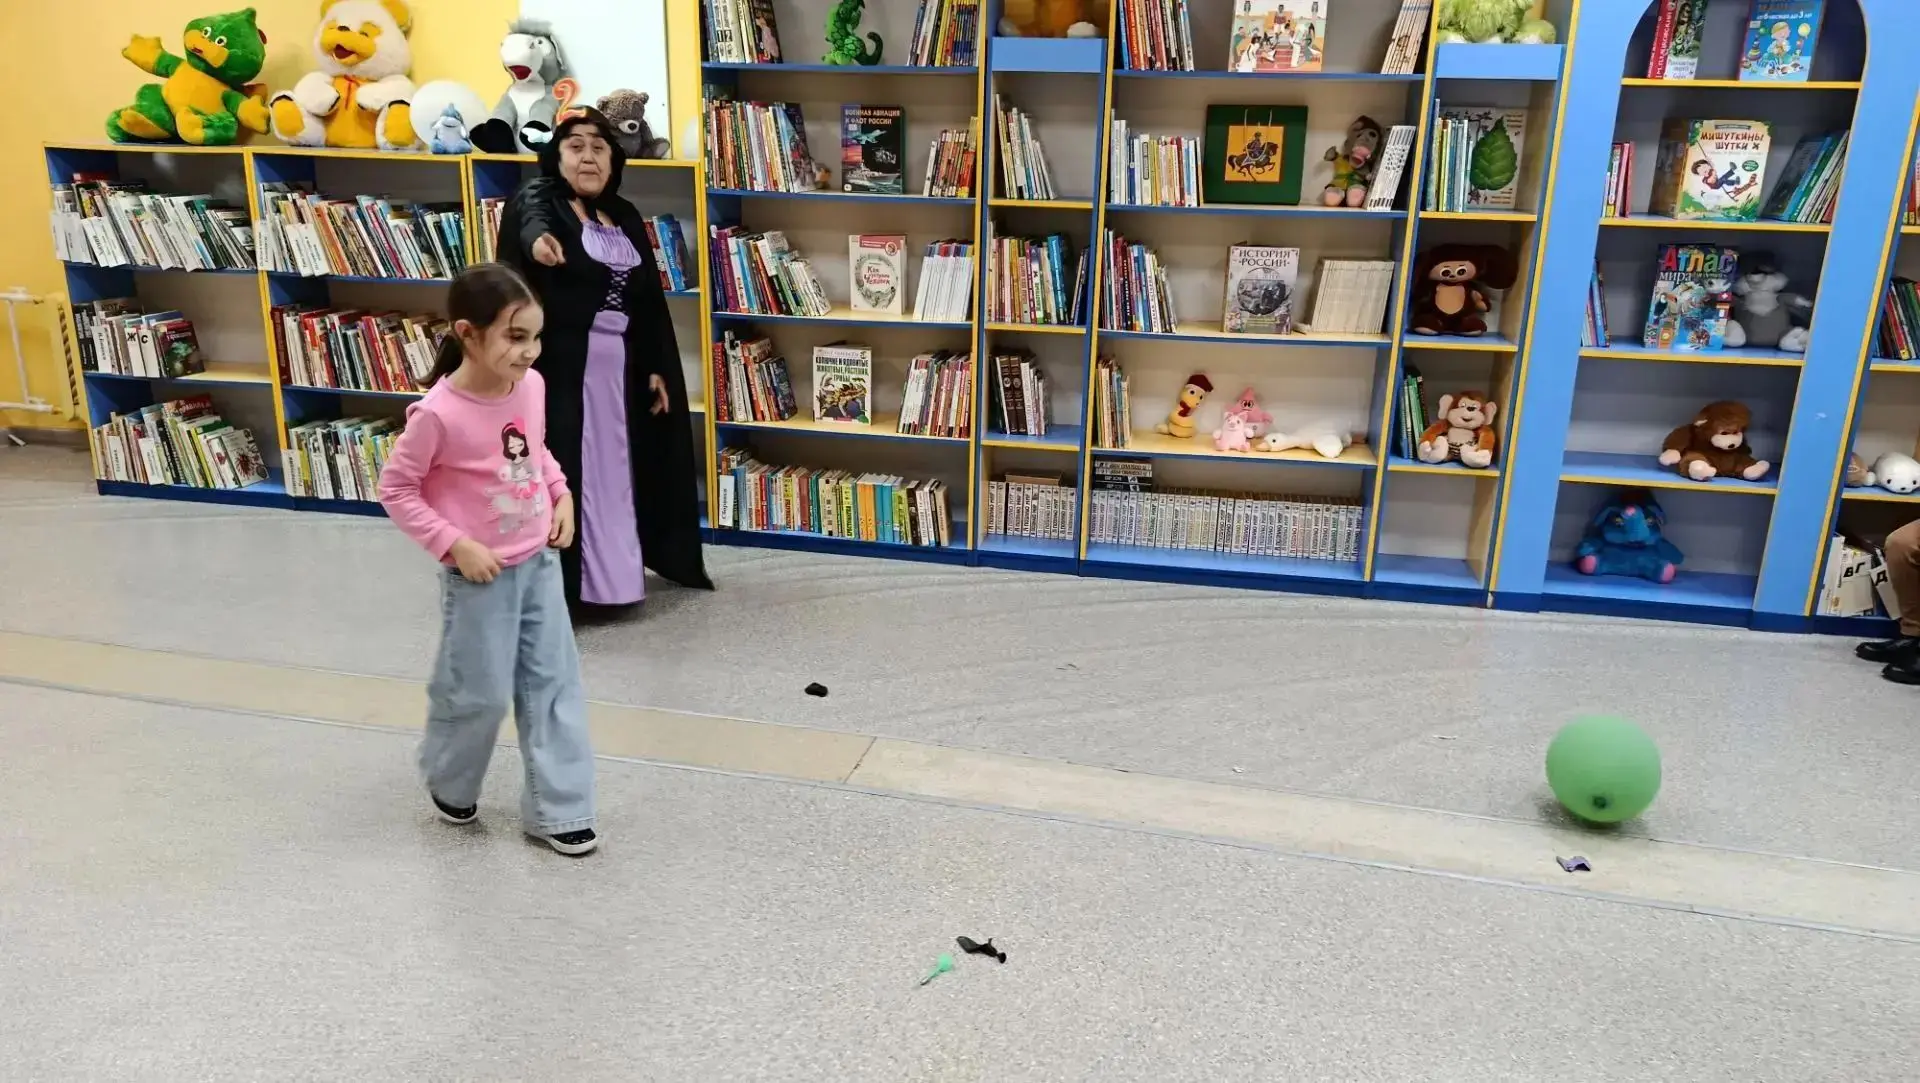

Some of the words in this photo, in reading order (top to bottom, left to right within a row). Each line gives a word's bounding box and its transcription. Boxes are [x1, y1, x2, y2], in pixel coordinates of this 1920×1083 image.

[1700, 132, 1764, 141] МИШУТКИНЫ
[1240, 250, 1290, 258] ИСТОРИЯ
[1242, 258, 1287, 267] РОССИИ
[1660, 272, 1692, 284] мира
[127, 332, 136, 342] Ж
[141, 334, 148, 344] С
[844, 359, 868, 367] ЯДОВИТЫЕ
[1843, 566, 1854, 577] В
[1855, 562, 1865, 573] Г
[1875, 570, 1888, 586] Д
